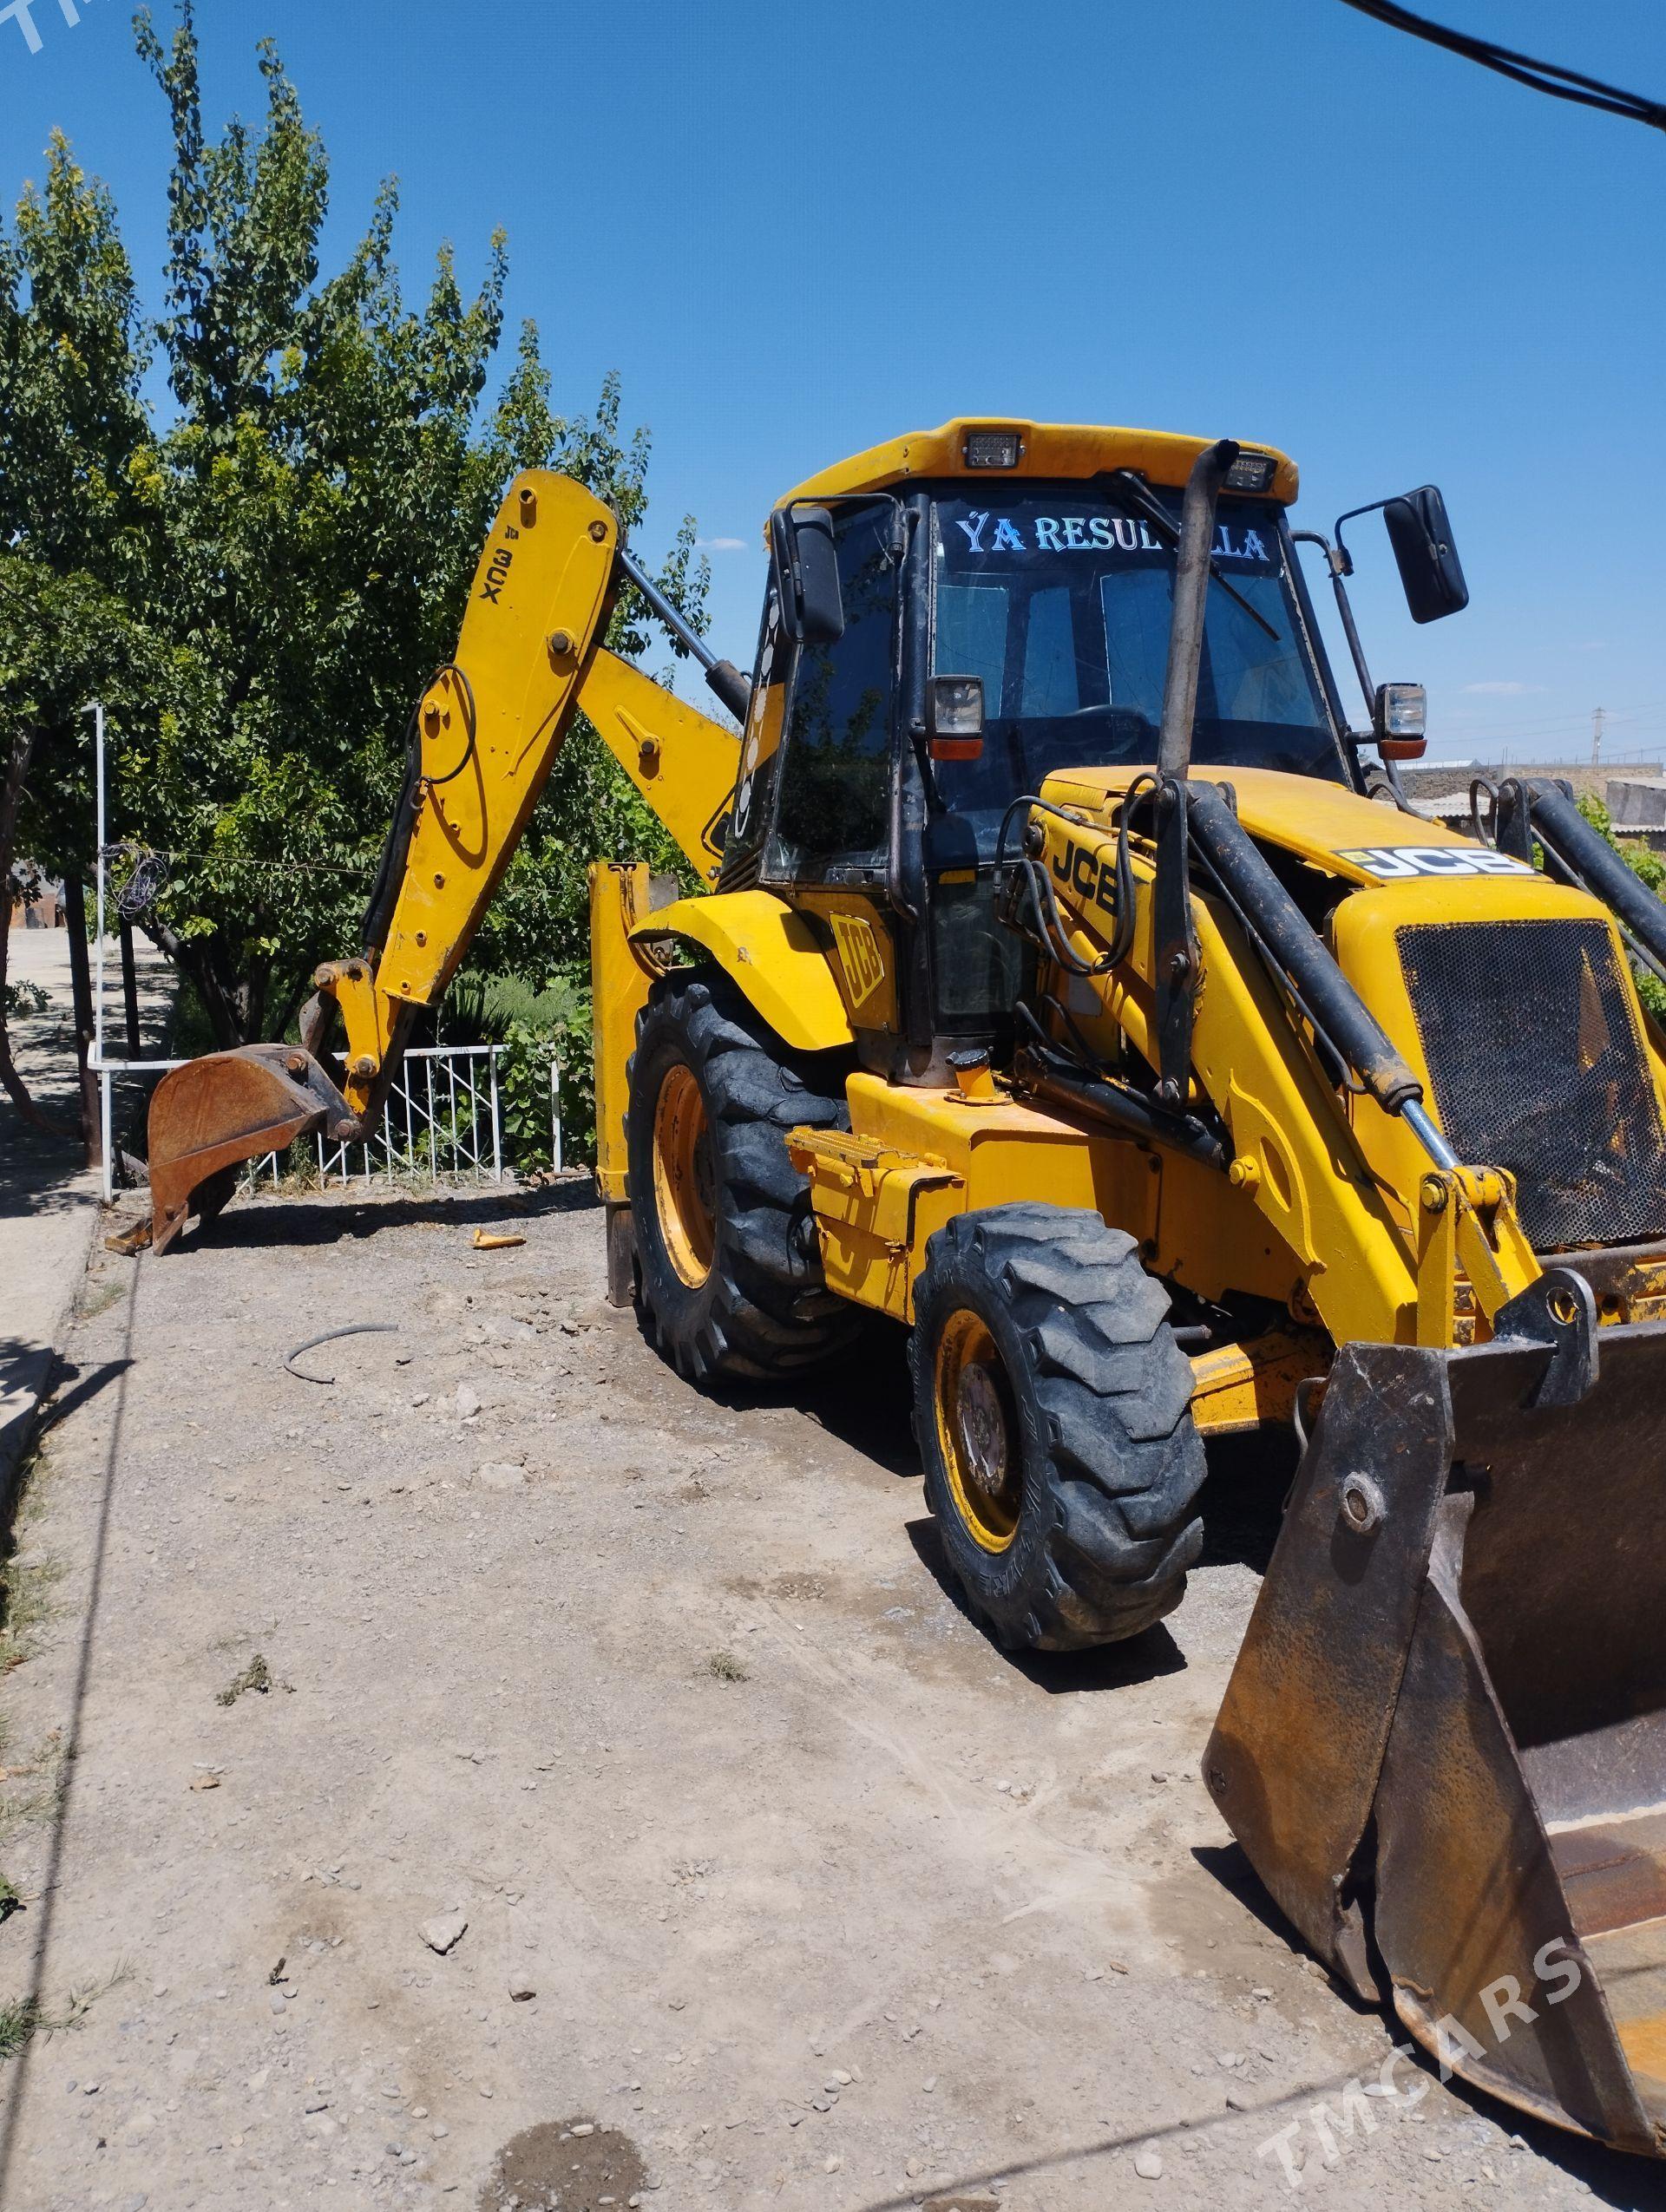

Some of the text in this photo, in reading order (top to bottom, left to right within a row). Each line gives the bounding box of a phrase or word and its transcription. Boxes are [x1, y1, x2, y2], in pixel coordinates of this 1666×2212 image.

[1034, 518, 1163, 553] RESUL
[479, 548, 513, 605] 3CX
[1362, 848, 1534, 876] JCB
[838, 922, 880, 1000] JCB
